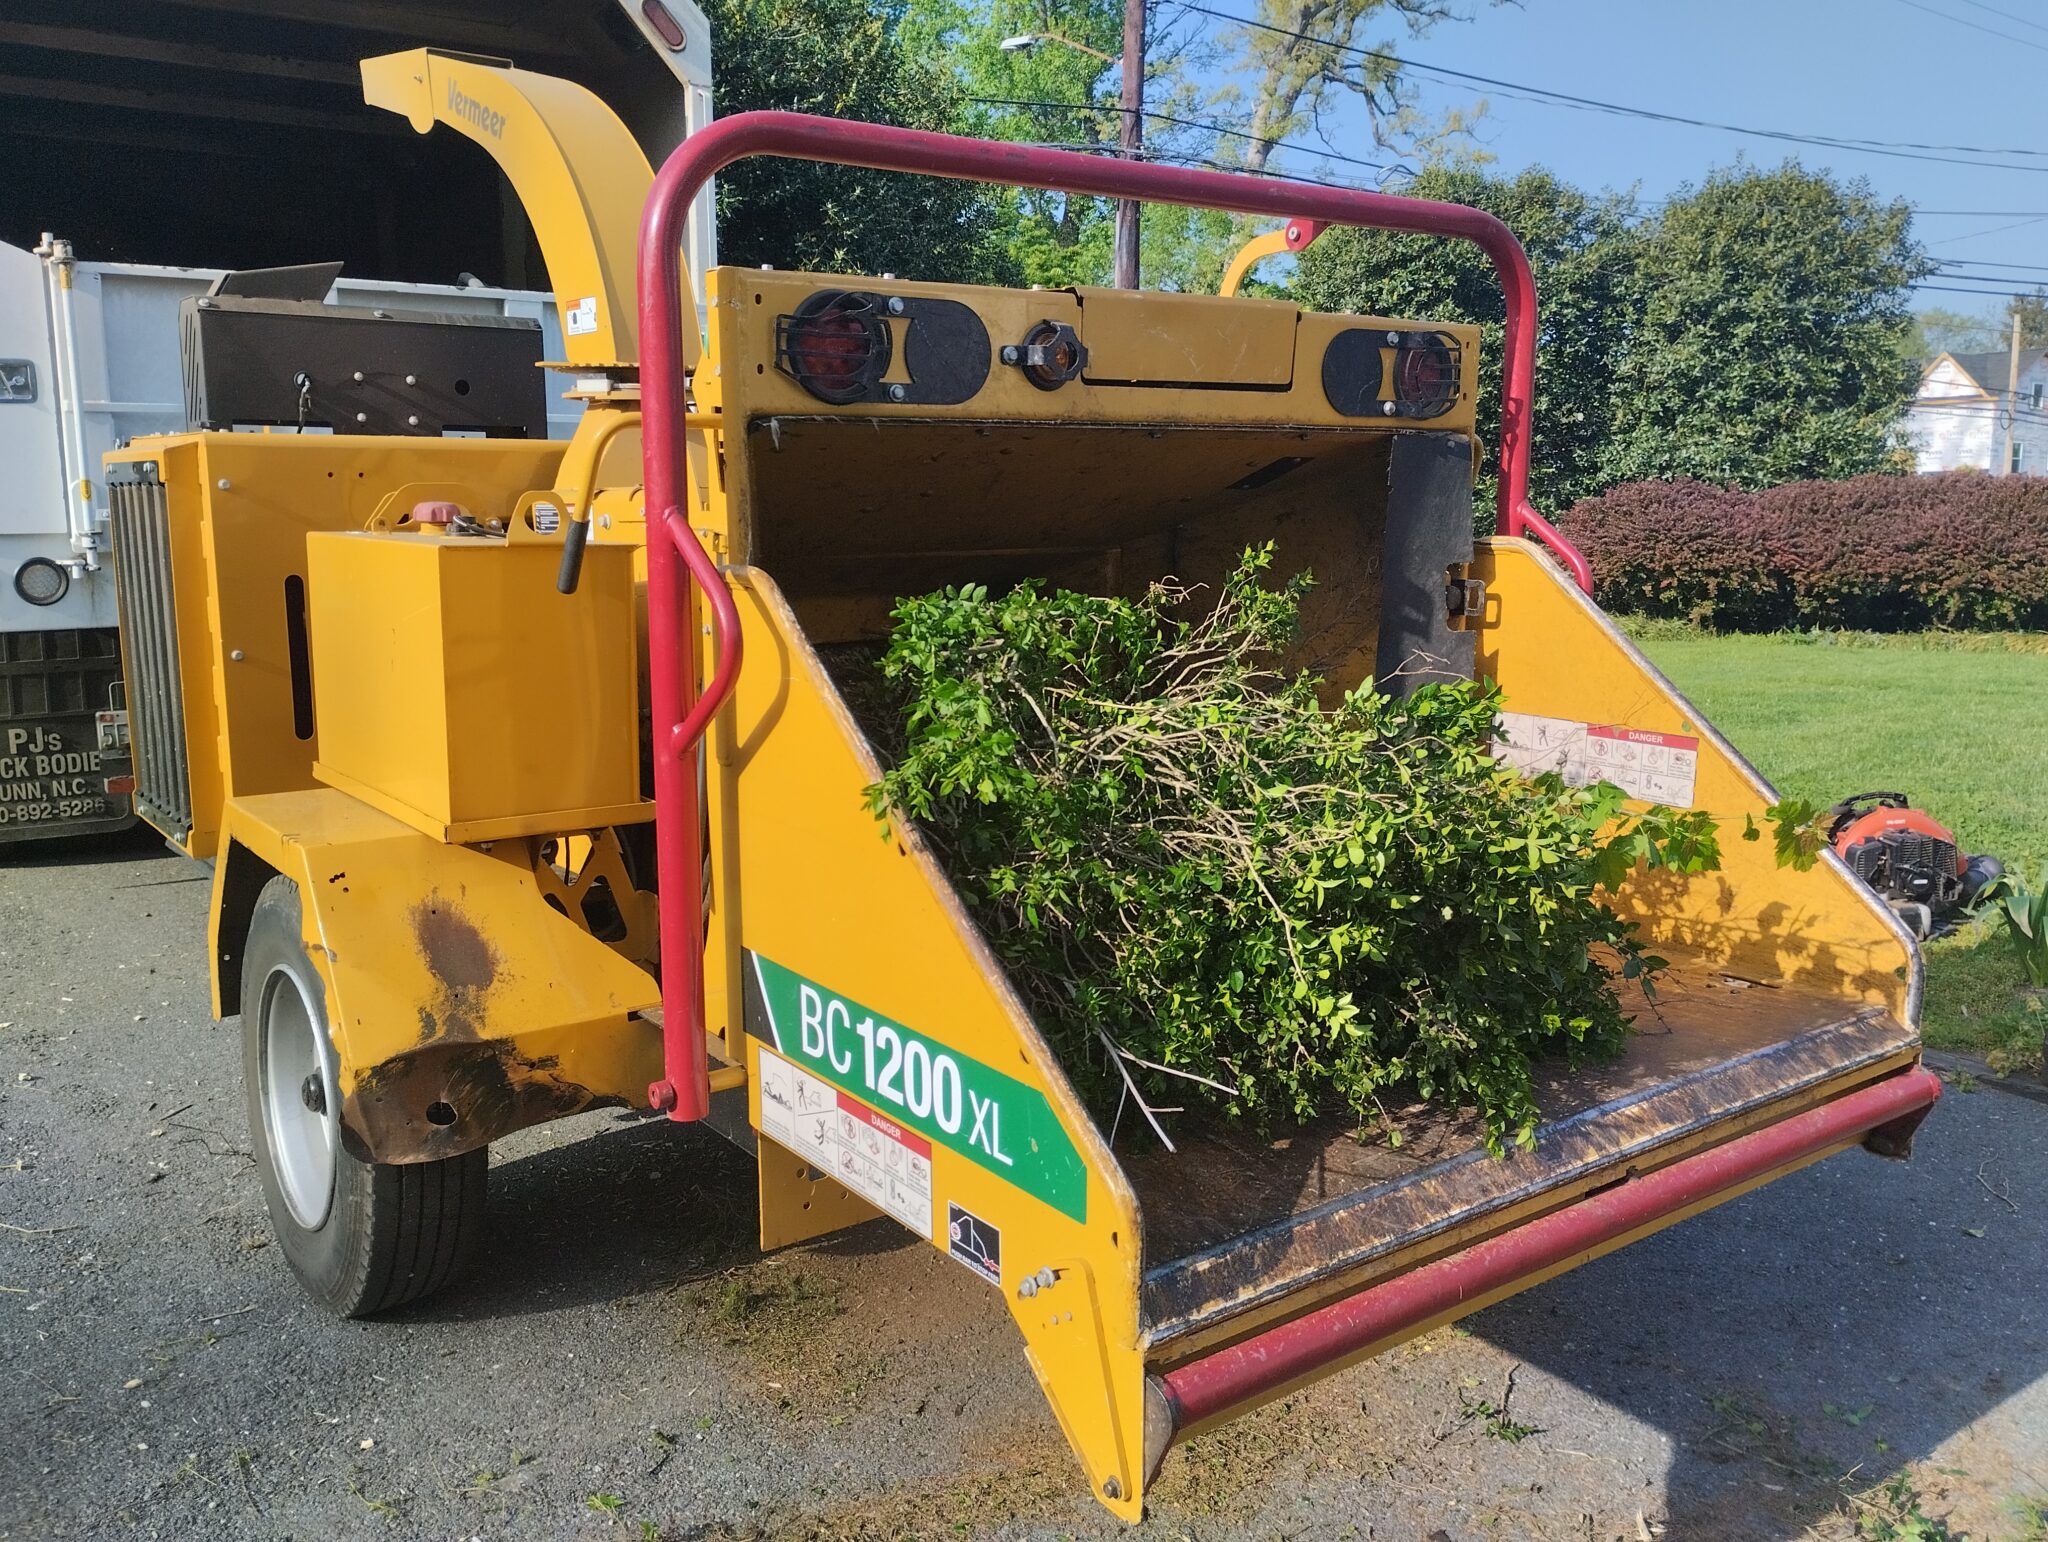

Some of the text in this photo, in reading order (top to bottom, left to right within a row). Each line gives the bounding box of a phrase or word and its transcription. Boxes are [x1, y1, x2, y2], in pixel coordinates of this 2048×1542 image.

[447, 76, 507, 140] Vermeer
[8, 726, 62, 755] PJ's
[1628, 731, 1664, 745] DANGER
[0, 751, 101, 779] CK BODIE
[52, 778, 91, 797] N.C.
[800, 983, 852, 1074] BC
[856, 1016, 962, 1134] 1200
[968, 1089, 1013, 1166] XL
[871, 1114, 902, 1140] DANGER
